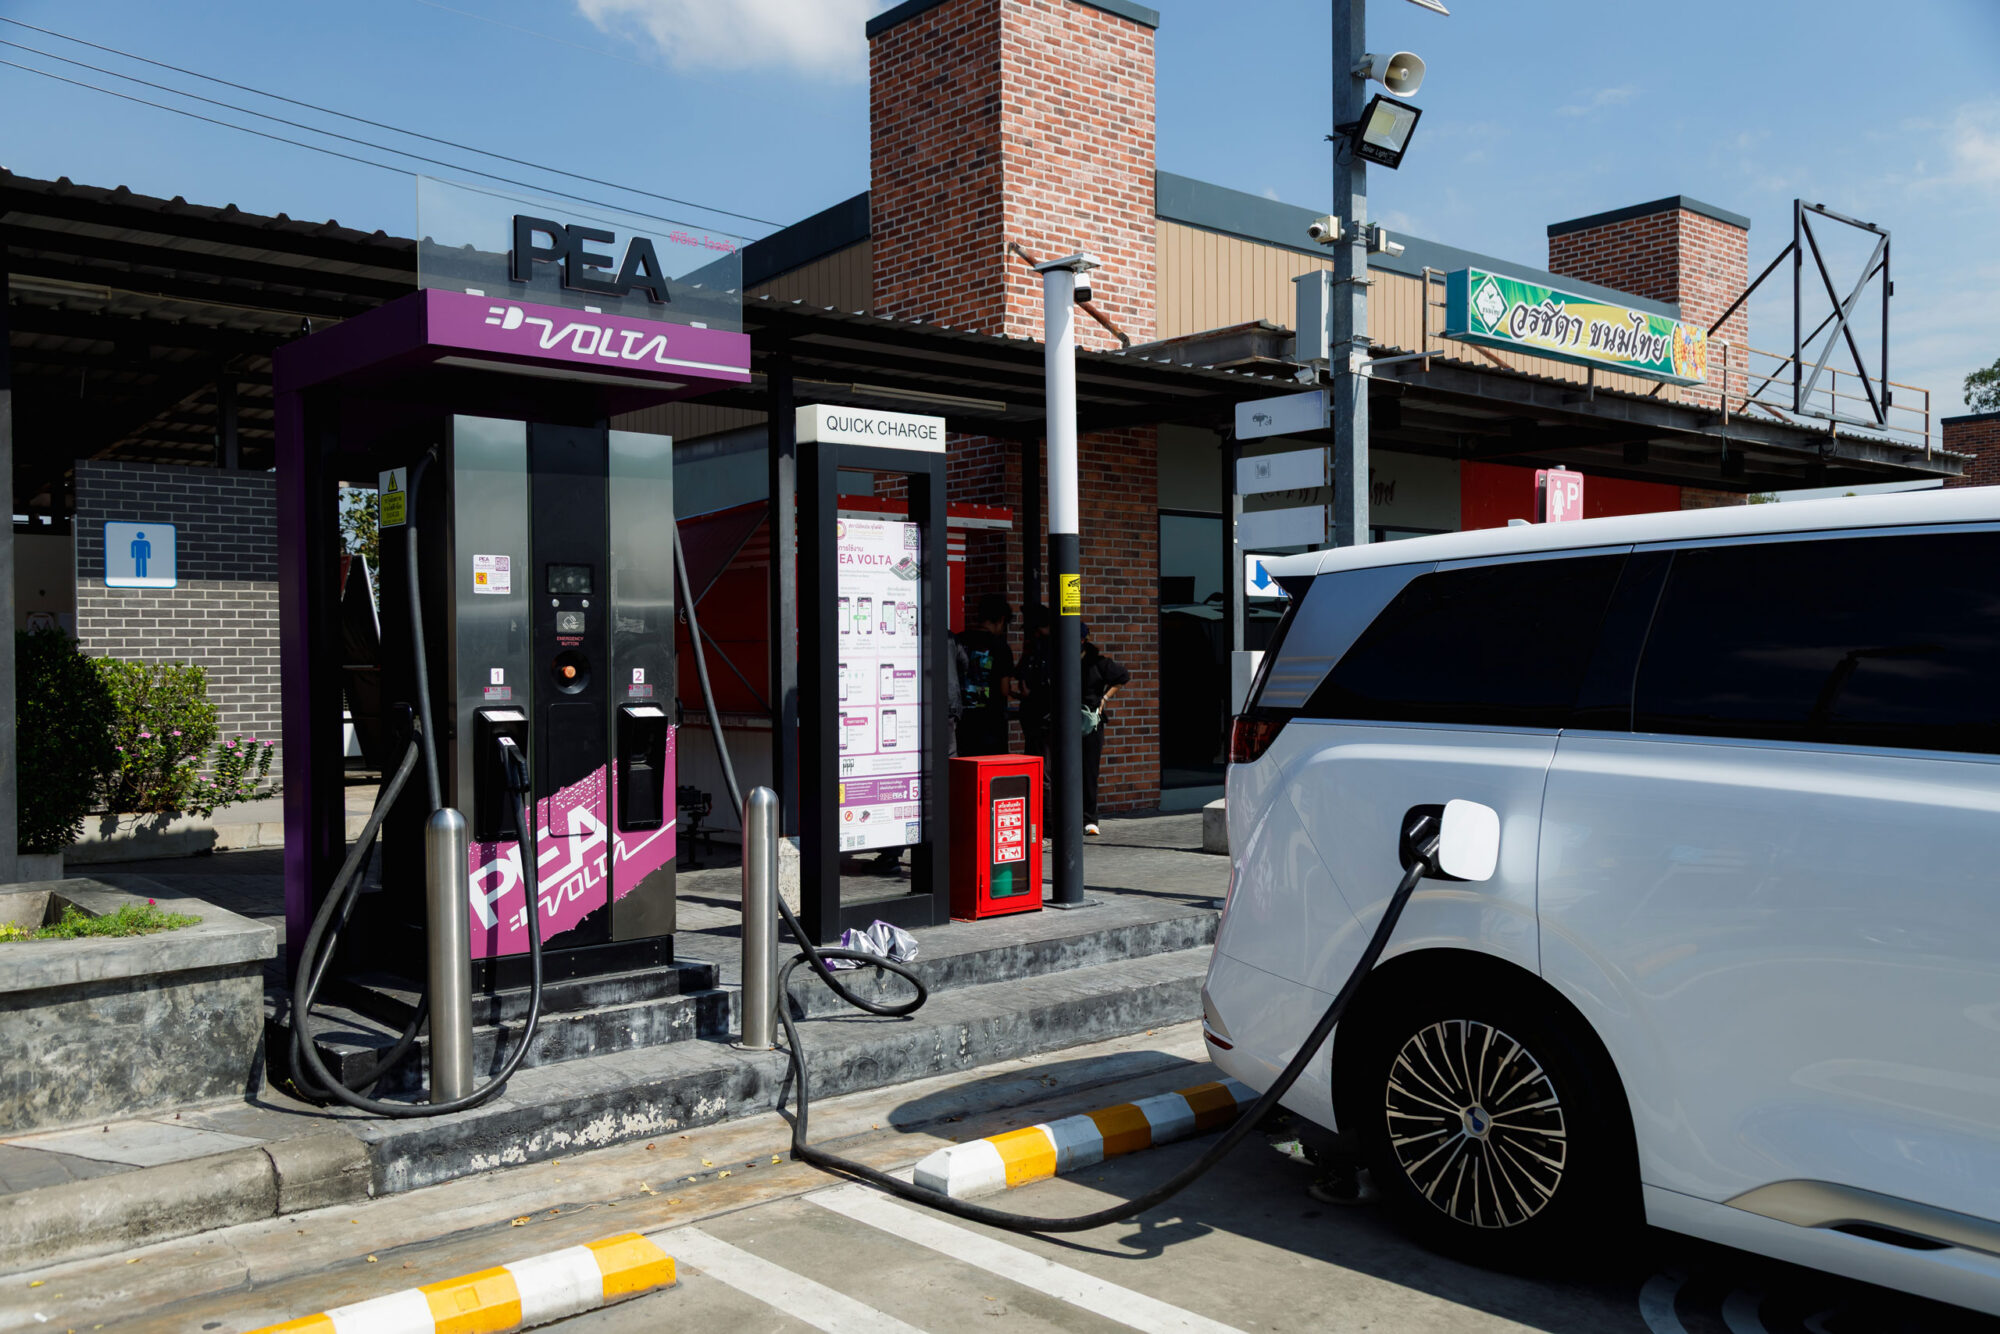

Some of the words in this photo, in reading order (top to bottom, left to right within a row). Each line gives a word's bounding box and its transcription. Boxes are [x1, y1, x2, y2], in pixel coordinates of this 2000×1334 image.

[512, 214, 671, 304] PEA
[525, 316, 750, 374] VOLTA
[1509, 301, 1583, 346] วรชิดา
[1590, 312, 1668, 363] ขนมไทย
[826, 415, 874, 434] QUICK
[877, 420, 937, 440] CHARGE
[1567, 482, 1579, 510] P
[839, 553, 854, 564] EA
[857, 554, 892, 566] VOLTA
[494, 671, 500, 682] 1
[635, 670, 642, 682] 2
[469, 804, 621, 930] PEA
